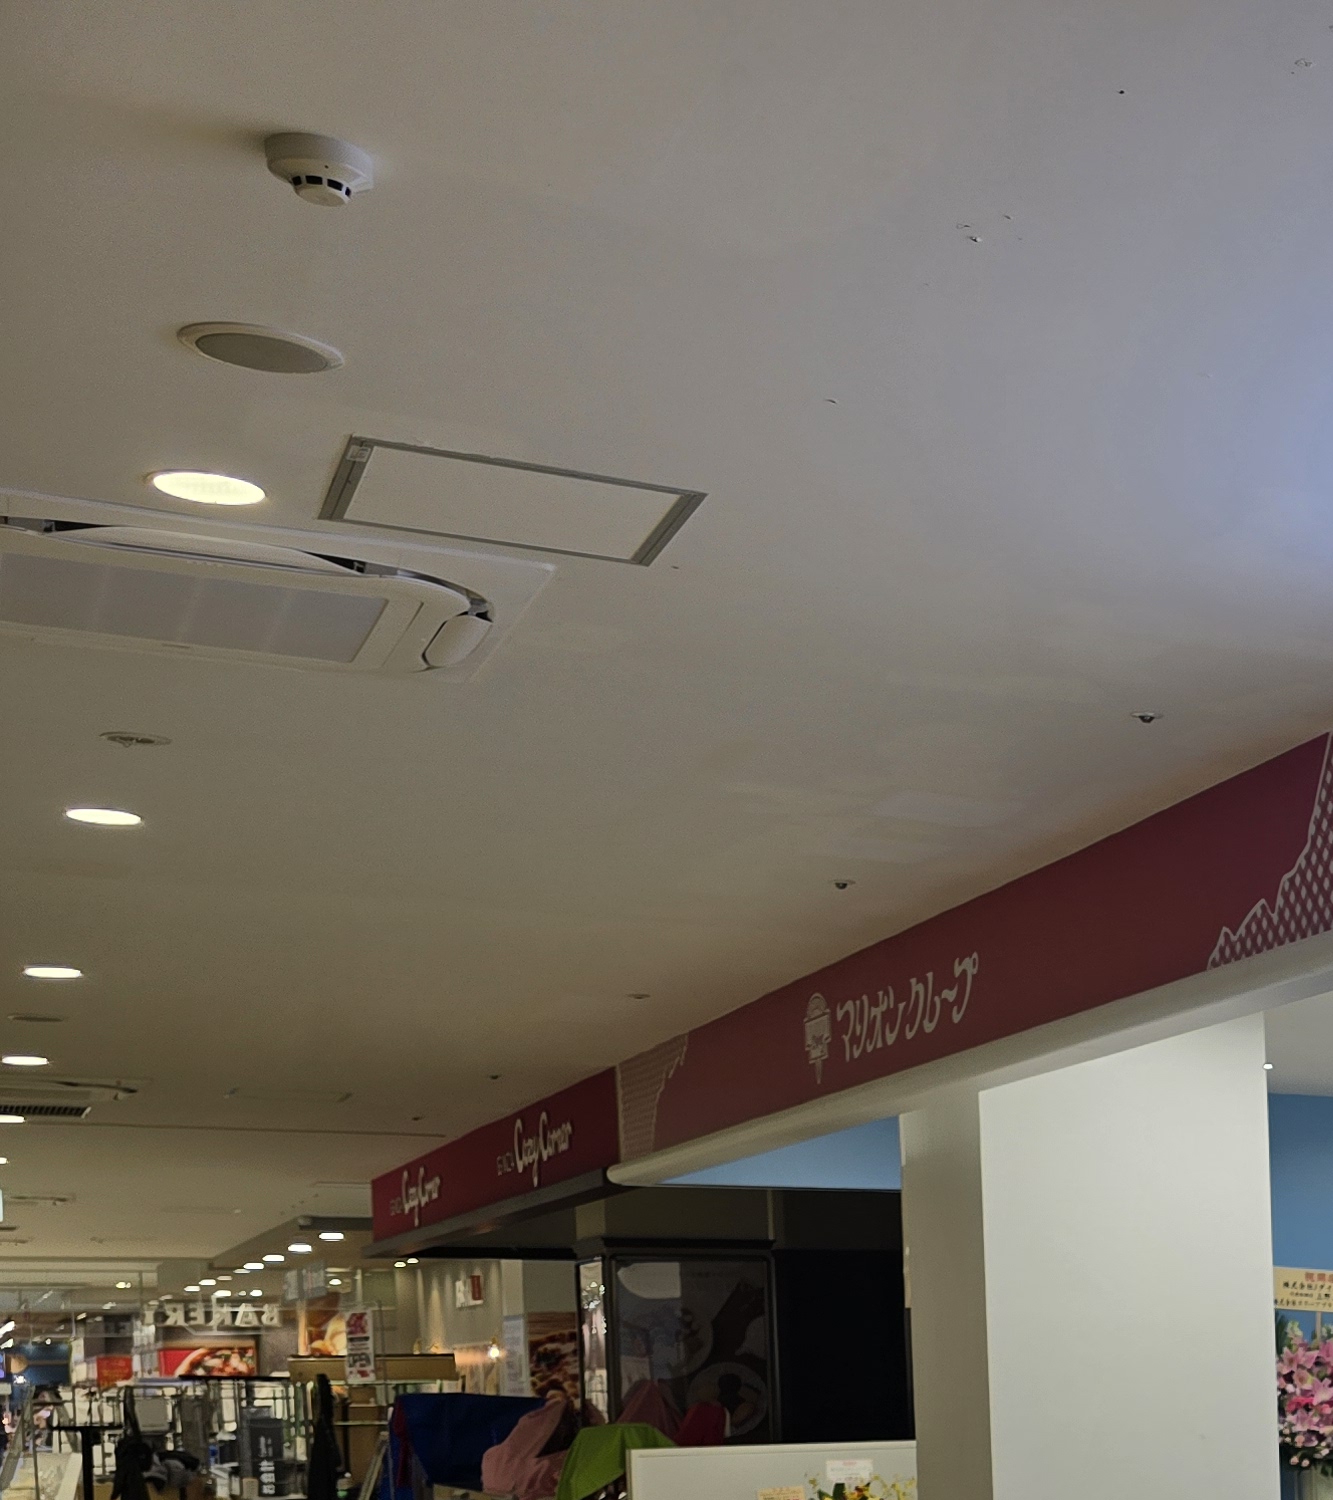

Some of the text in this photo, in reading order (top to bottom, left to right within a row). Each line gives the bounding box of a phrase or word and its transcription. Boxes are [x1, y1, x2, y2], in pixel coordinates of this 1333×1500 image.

[837, 951, 979, 1063] マリオンクレープ
